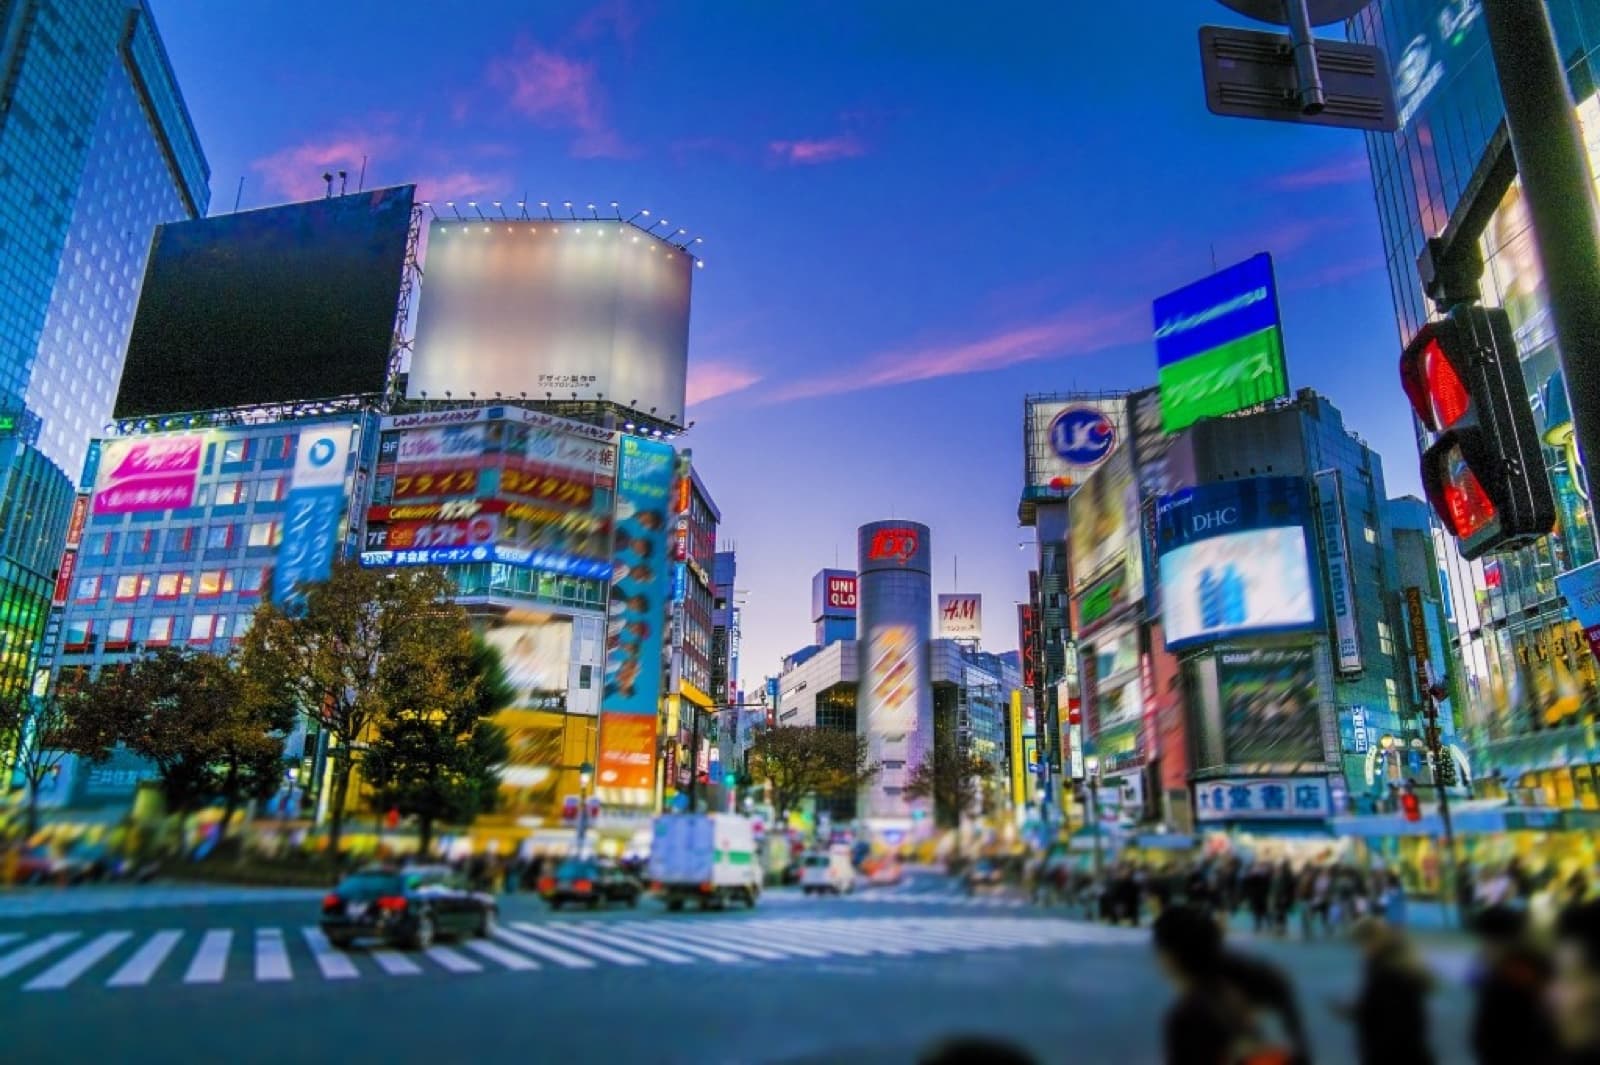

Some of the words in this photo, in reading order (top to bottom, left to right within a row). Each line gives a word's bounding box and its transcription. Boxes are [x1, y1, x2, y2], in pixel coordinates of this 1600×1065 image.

[383, 442, 398, 452] 9F
[1192, 507, 1238, 532] DHC
[369, 532, 387, 545] 7F
[832, 580, 853, 592] UNI
[832, 592, 855, 605] QLO
[944, 600, 975, 620] H&M
